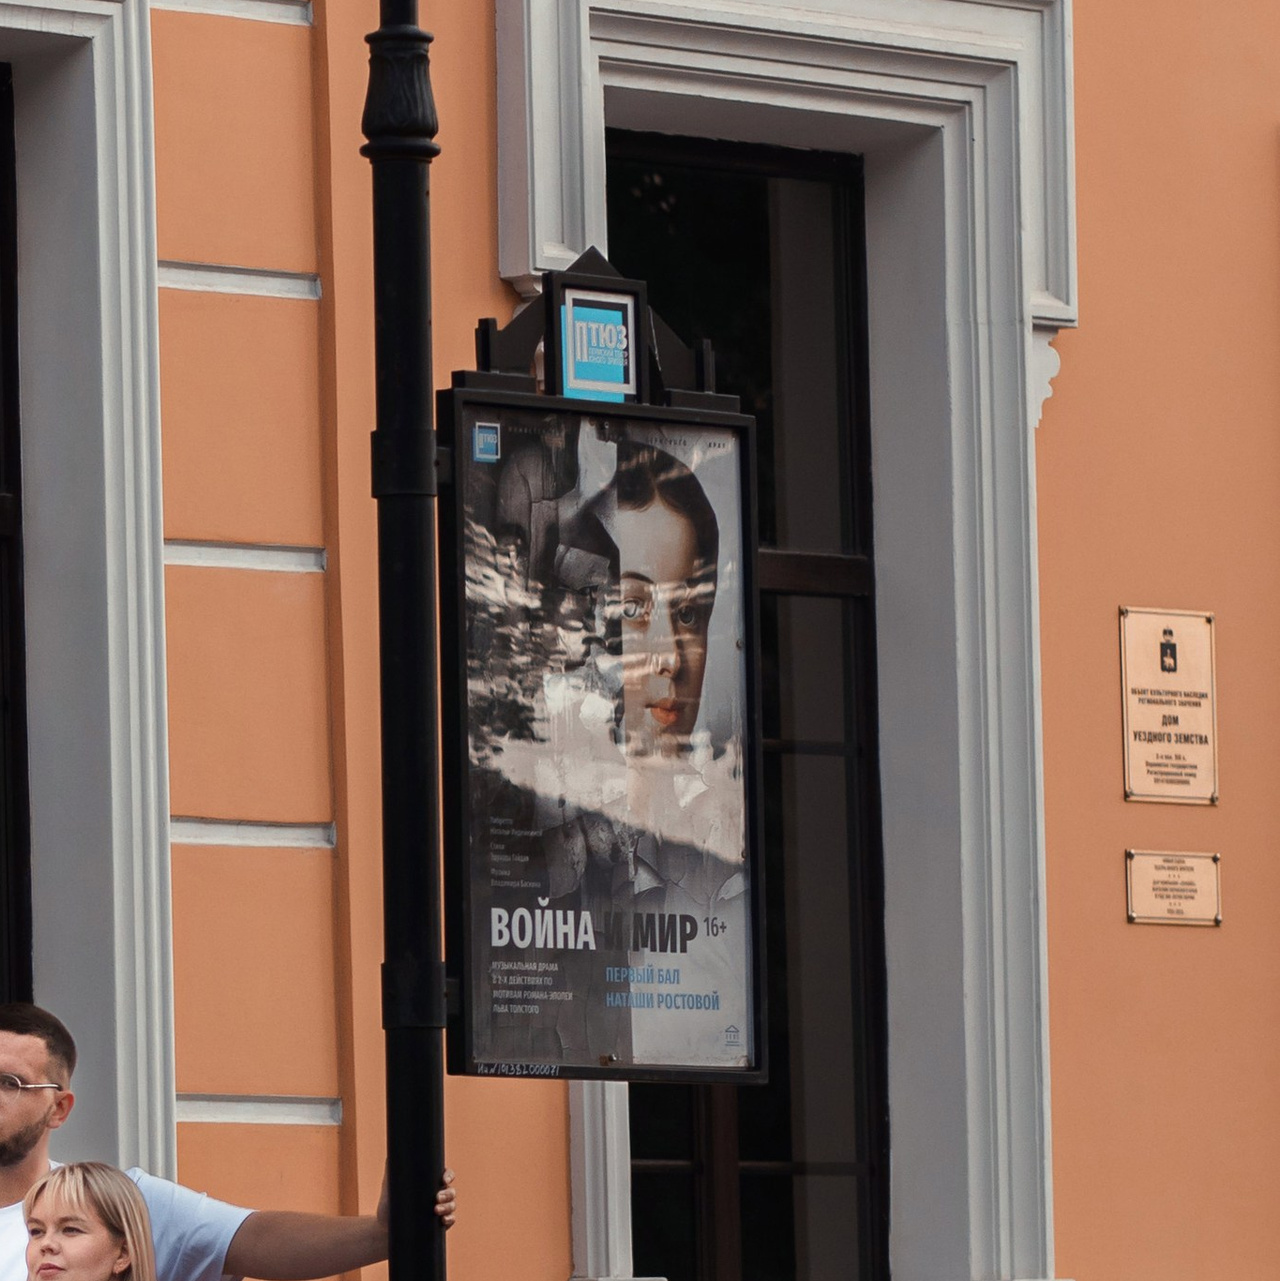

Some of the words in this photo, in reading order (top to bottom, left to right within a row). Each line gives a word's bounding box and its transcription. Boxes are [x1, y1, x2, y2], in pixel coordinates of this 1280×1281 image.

[575, 321, 628, 362] ПТЮЗ
[1162, 714, 1180, 727] ДОМ
[1133, 730, 1172, 744] УЕЗДНОГО
[1174, 732, 1210, 745] ЗЕМСТВА
[491, 896, 596, 951] ВОЙНА
[632, 912, 699, 954] МИР
[703, 916, 727, 938] 16+
[606, 964, 654, 984] ПЕРВЫЙ
[657, 968, 681, 985] БАЛ
[510, 1004, 540, 1014] ТОЛСТОГО
[606, 991, 654, 1009] НАТАШИ
[657, 990, 720, 1011] РОСТОВОЙ
